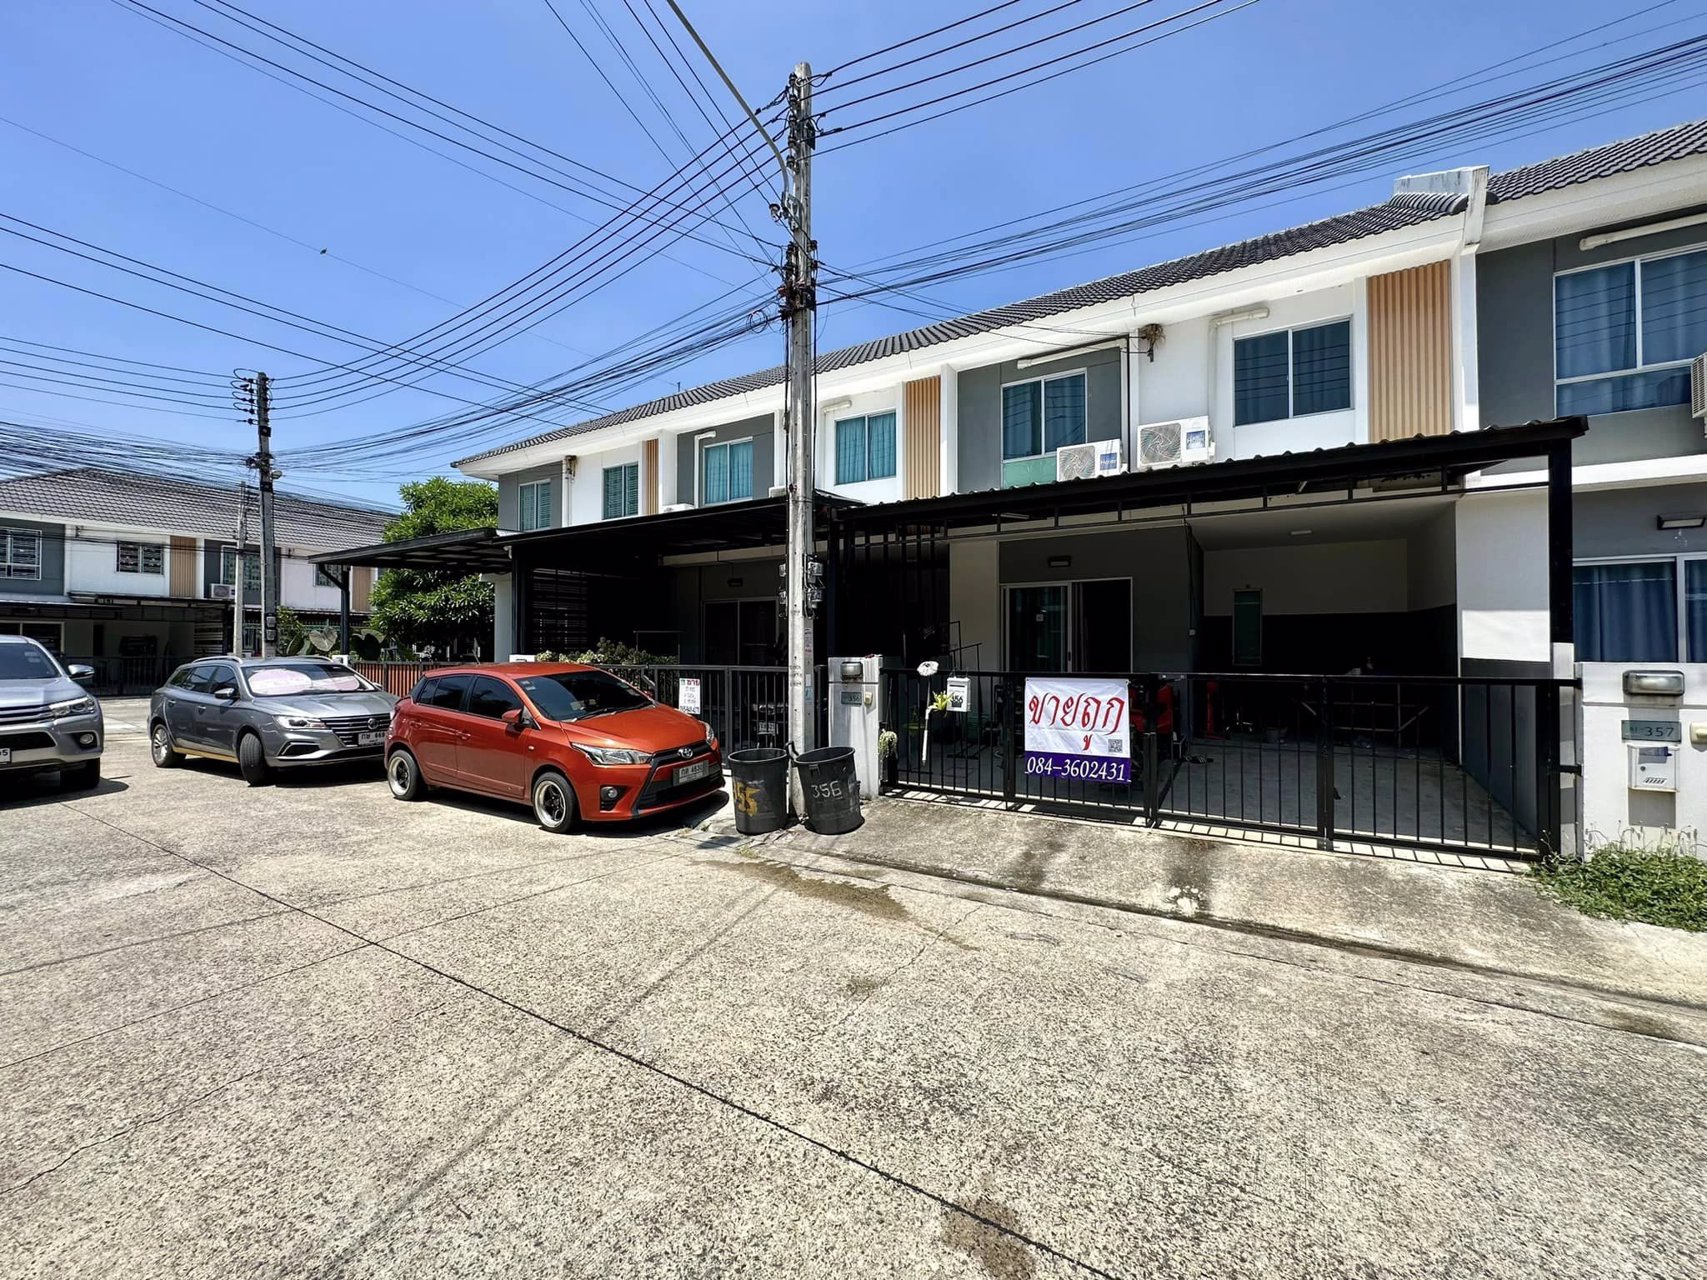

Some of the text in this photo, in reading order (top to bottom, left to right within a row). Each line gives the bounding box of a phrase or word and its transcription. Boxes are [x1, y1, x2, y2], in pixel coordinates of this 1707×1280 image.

[1029, 692, 1125, 751] ขายถูก
[1643, 726, 1675, 738] 357
[1027, 757, 1125, 781] 084-3602431
[811, 780, 842, 798] 356
